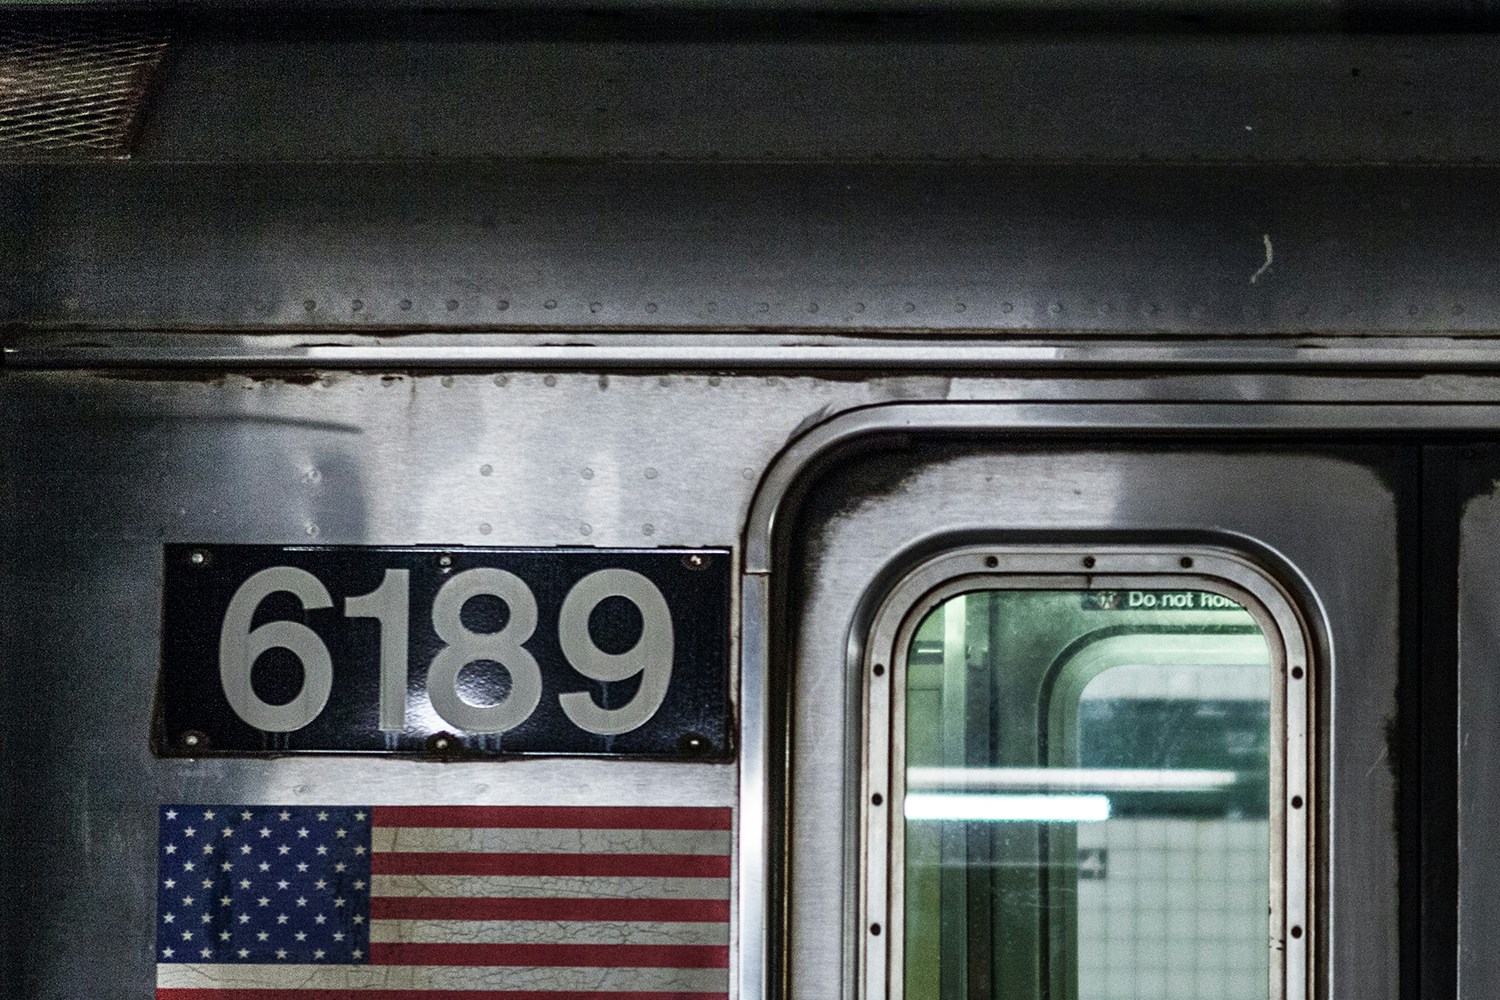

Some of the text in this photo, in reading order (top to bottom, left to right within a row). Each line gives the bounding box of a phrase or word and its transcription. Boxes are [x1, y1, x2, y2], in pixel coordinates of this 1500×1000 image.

[1129, 591, 1156, 607] Do
[1162, 591, 1194, 607] not
[218, 566, 676, 736] 6189
